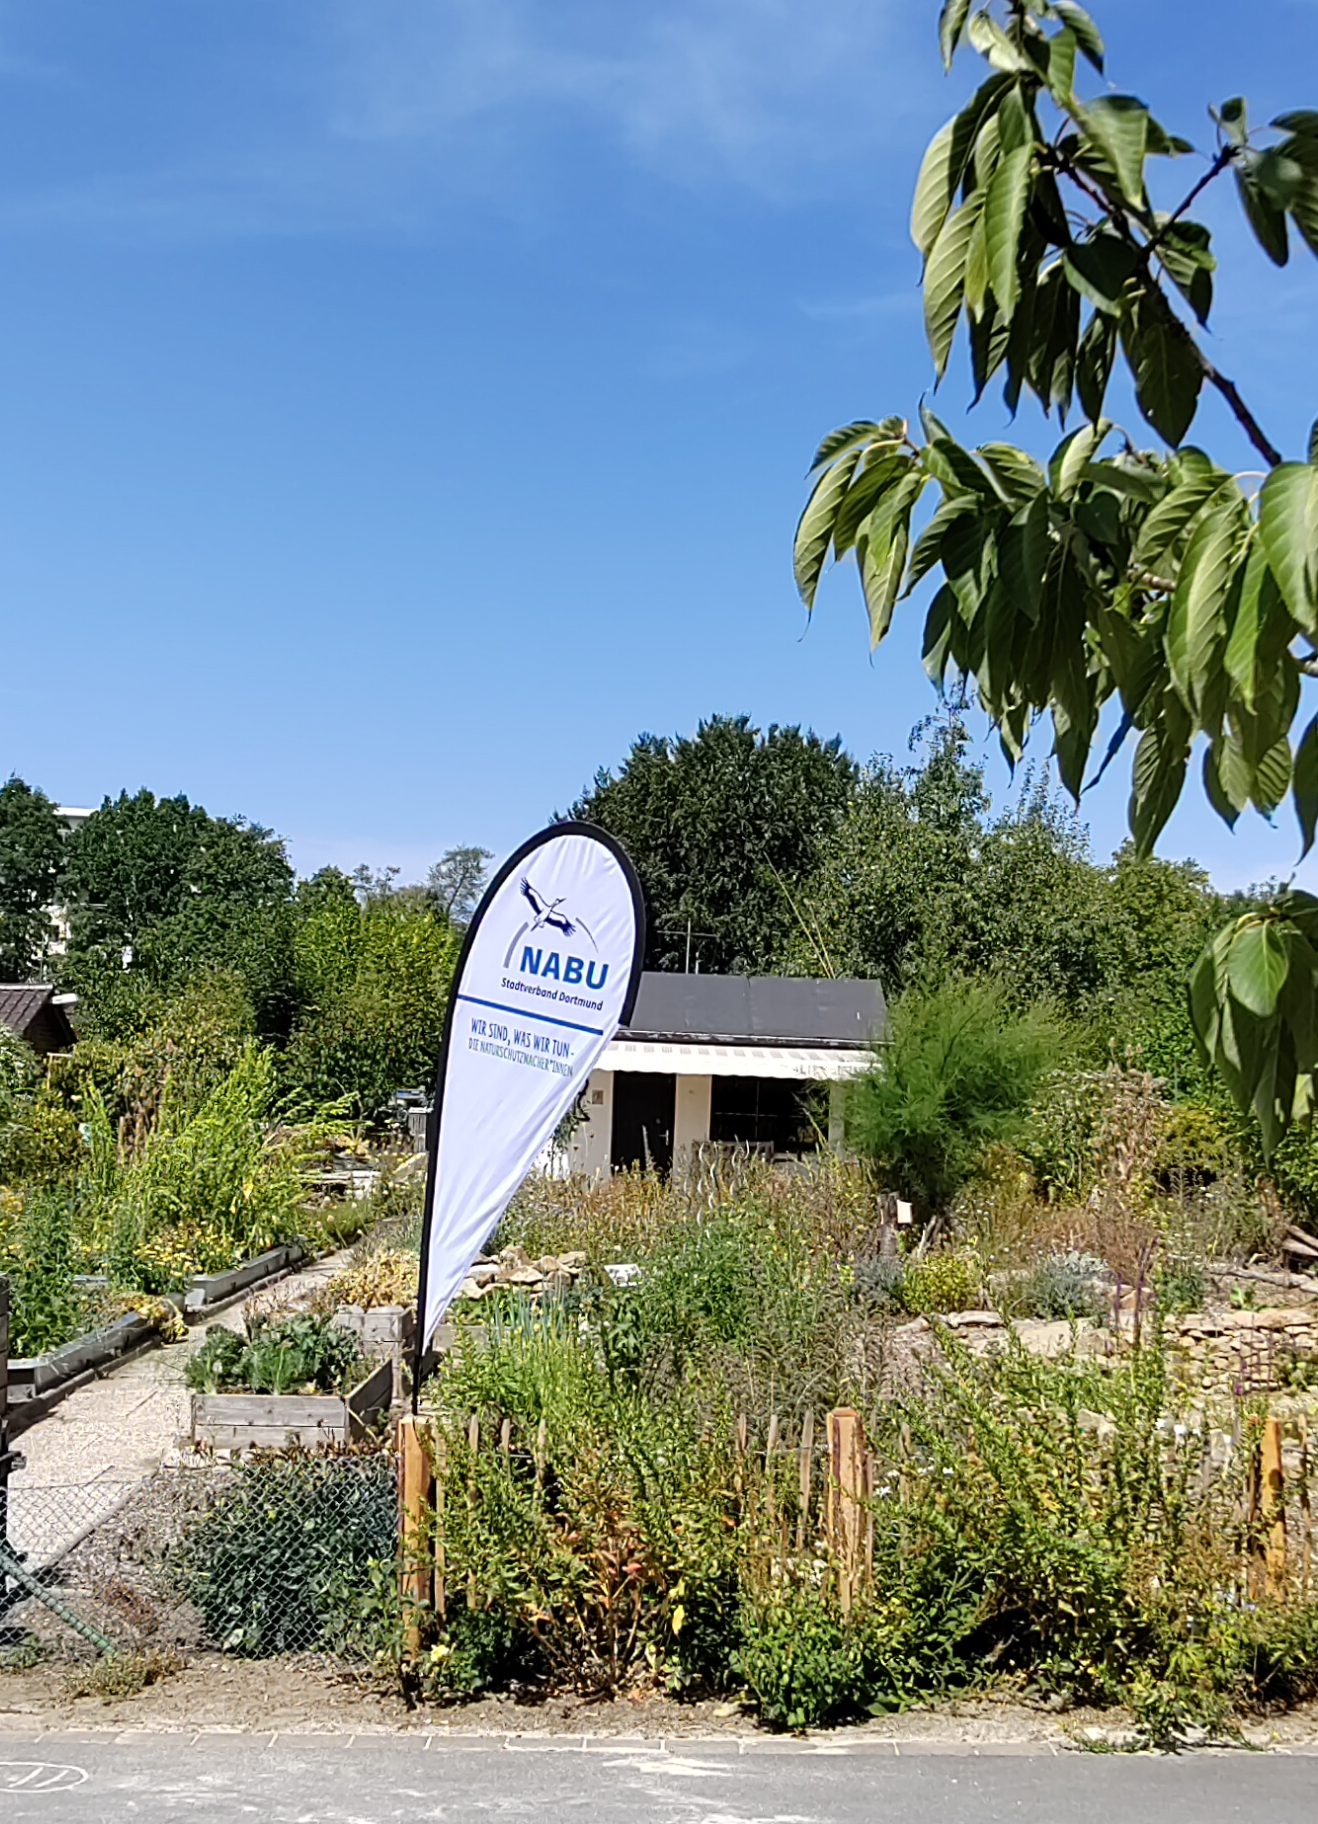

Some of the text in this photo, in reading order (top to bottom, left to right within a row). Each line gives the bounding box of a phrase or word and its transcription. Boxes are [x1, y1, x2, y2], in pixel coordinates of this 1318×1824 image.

[520, 946, 609, 990] NABU
[501, 977, 604, 1011] Stadtverband Dortmund
[468, 1037, 480, 1051] DIE
[471, 1018, 486, 1036] WIR
[488, 1023, 511, 1046] SIND,
[514, 1029, 531, 1048] WAS
[533, 1034, 550, 1053] WIR
